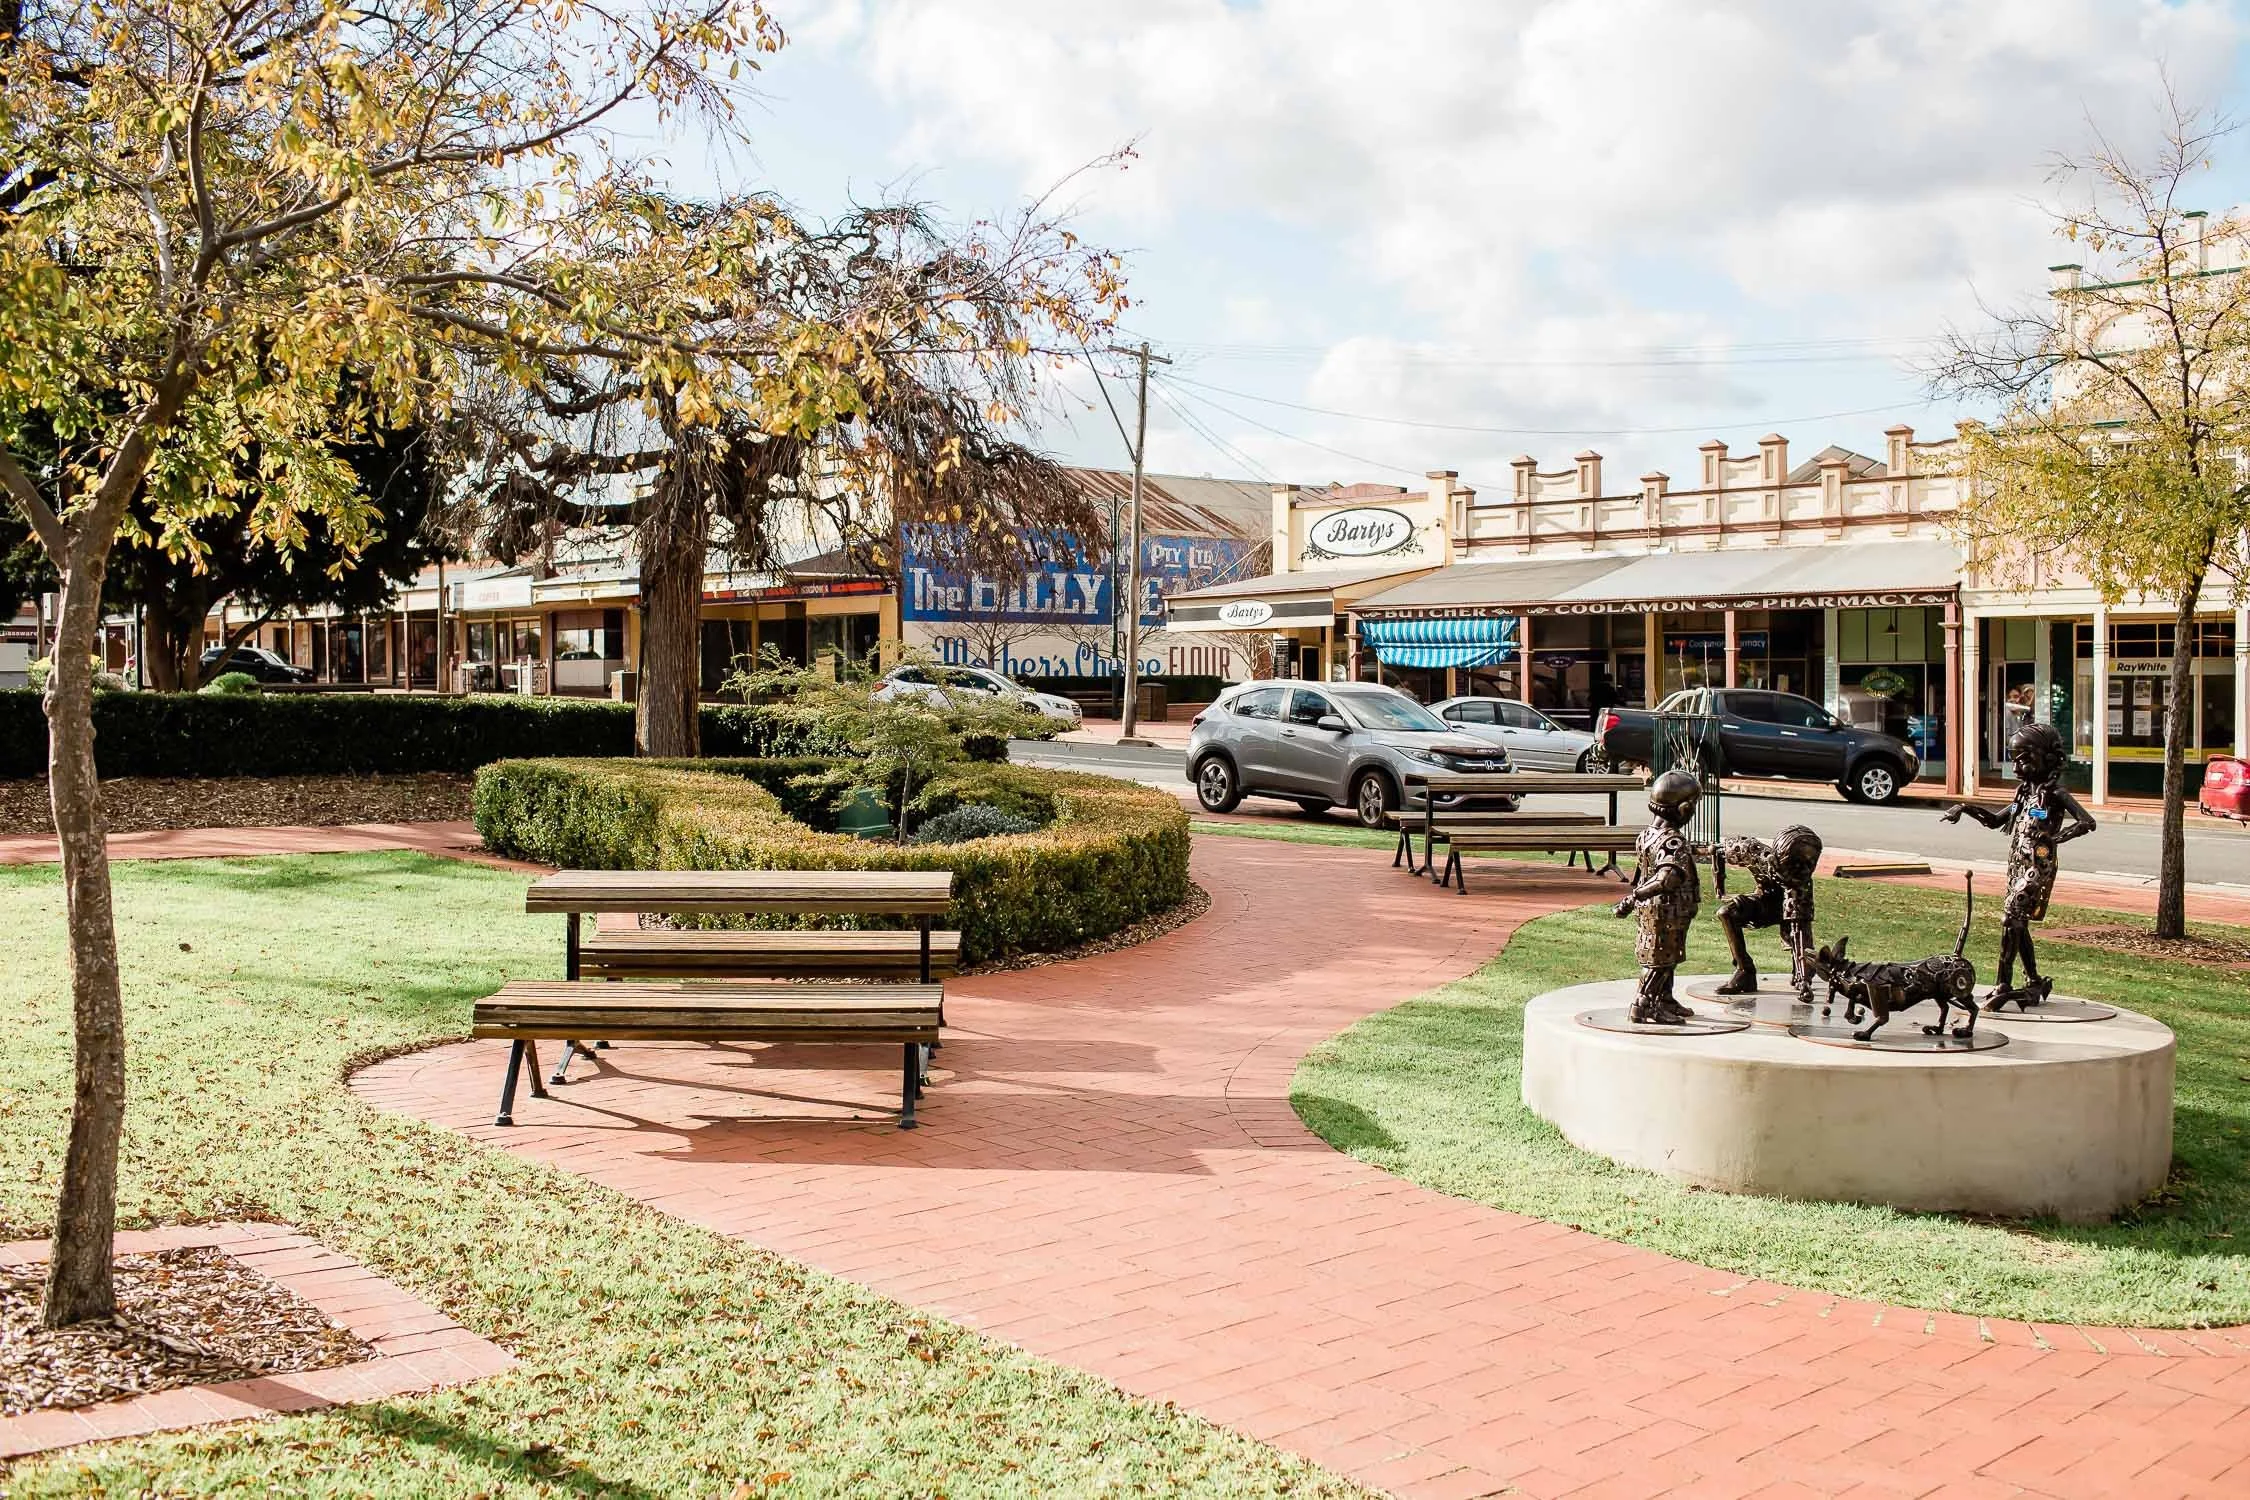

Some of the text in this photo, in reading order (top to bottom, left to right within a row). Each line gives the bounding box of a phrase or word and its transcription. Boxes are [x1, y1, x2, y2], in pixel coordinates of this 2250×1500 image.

[1327, 518, 1394, 548] Bartys
[909, 568, 966, 612] The
[1226, 604, 1264, 620] Bartys
[1384, 607, 1487, 618] BUTCHER
[1554, 594, 1917, 615] COOLAMON PHARMACY
[1169, 646, 1231, 679] FLOUR
